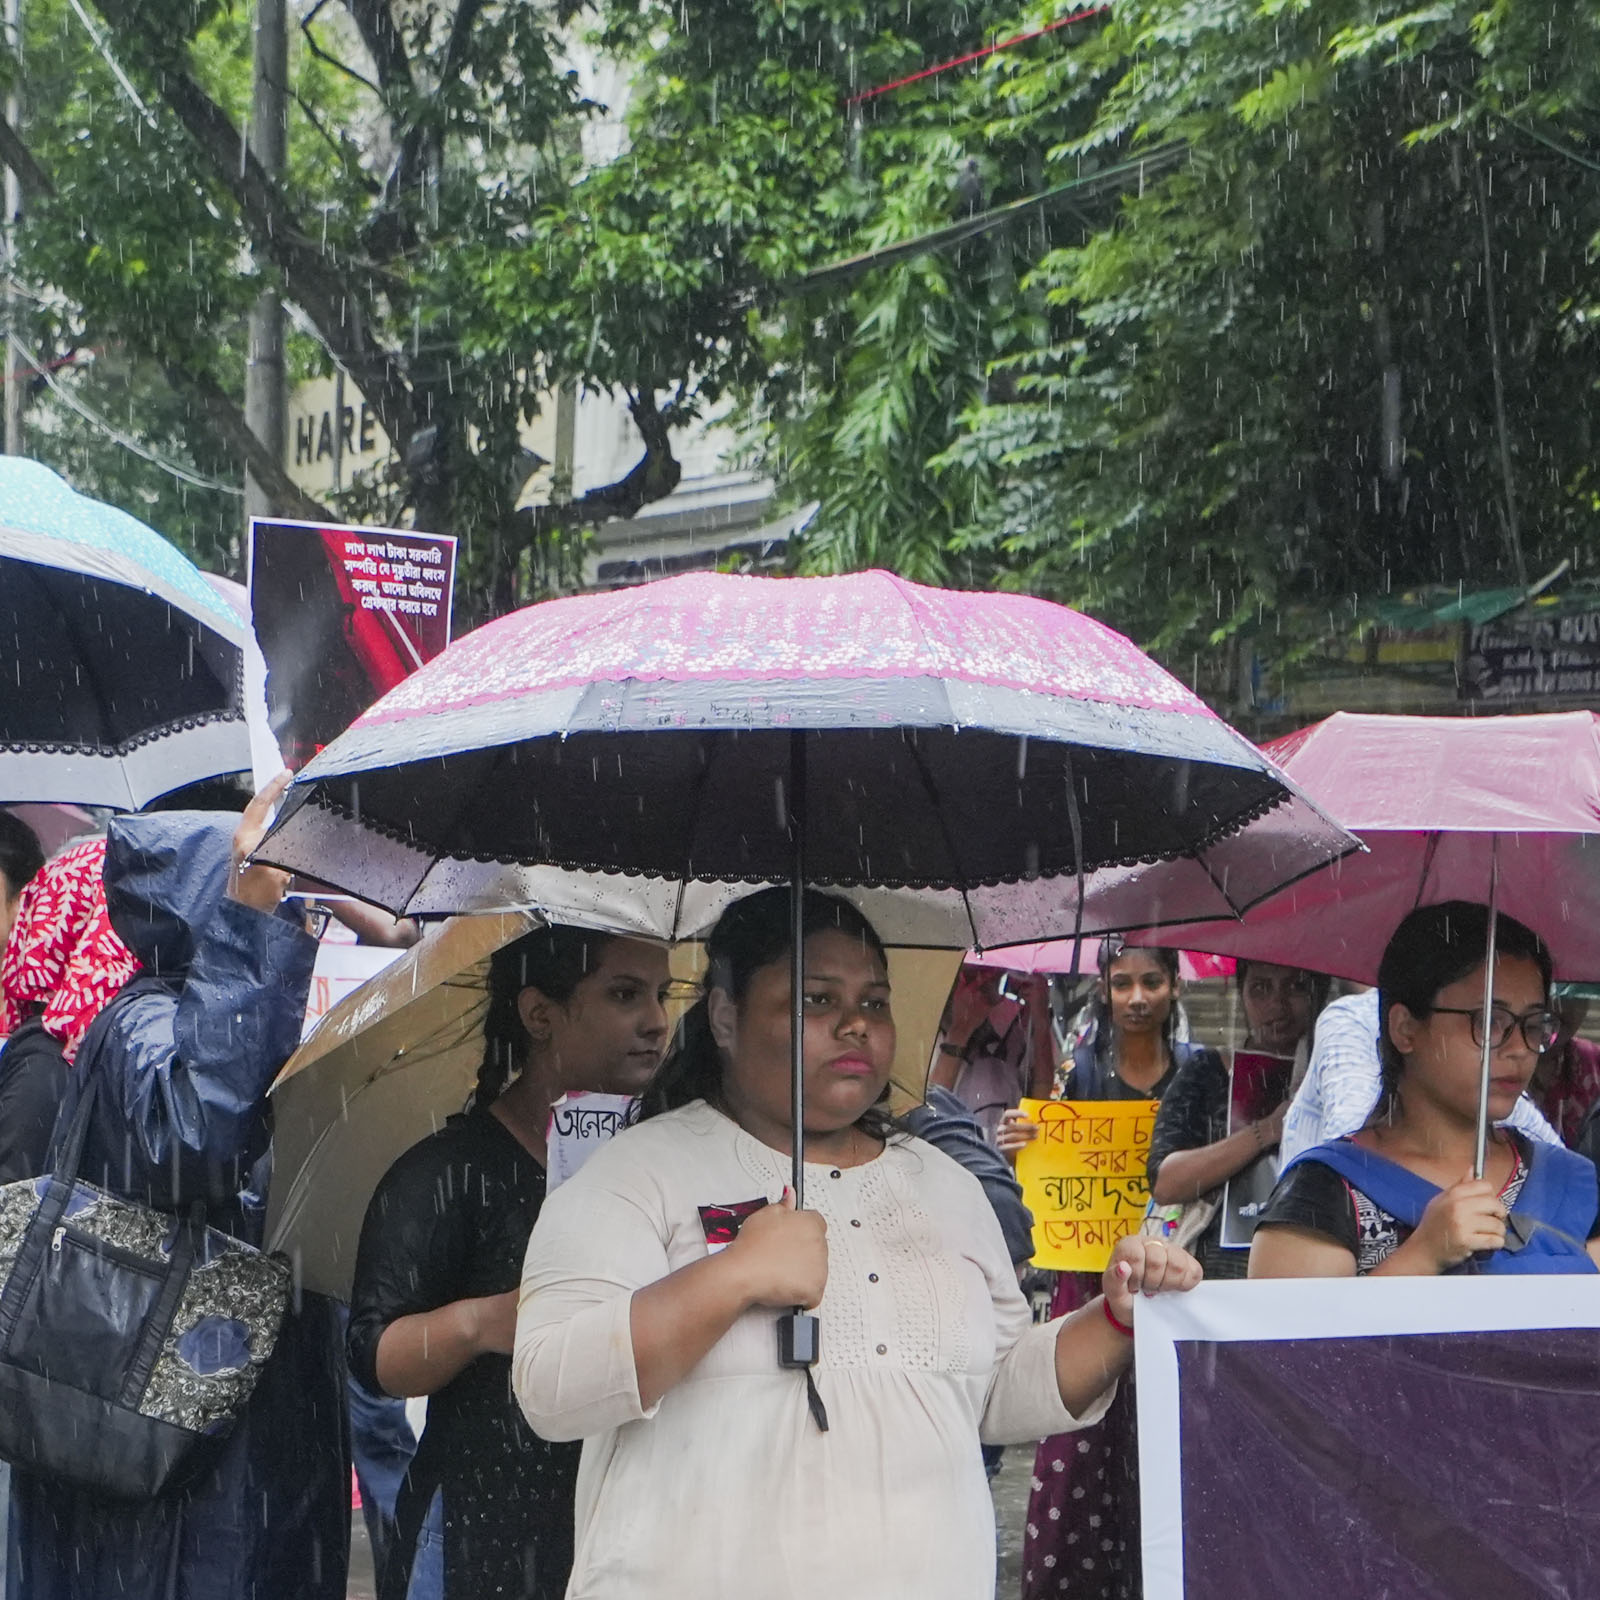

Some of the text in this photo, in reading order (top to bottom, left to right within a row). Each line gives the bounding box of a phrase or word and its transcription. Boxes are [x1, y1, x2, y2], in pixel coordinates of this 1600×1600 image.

[344, 543, 364, 555] লাখ
[367, 543, 385, 557] লাখ
[386, 541, 407, 559] টাকা
[1037, 1103, 1114, 1144] বিচার
